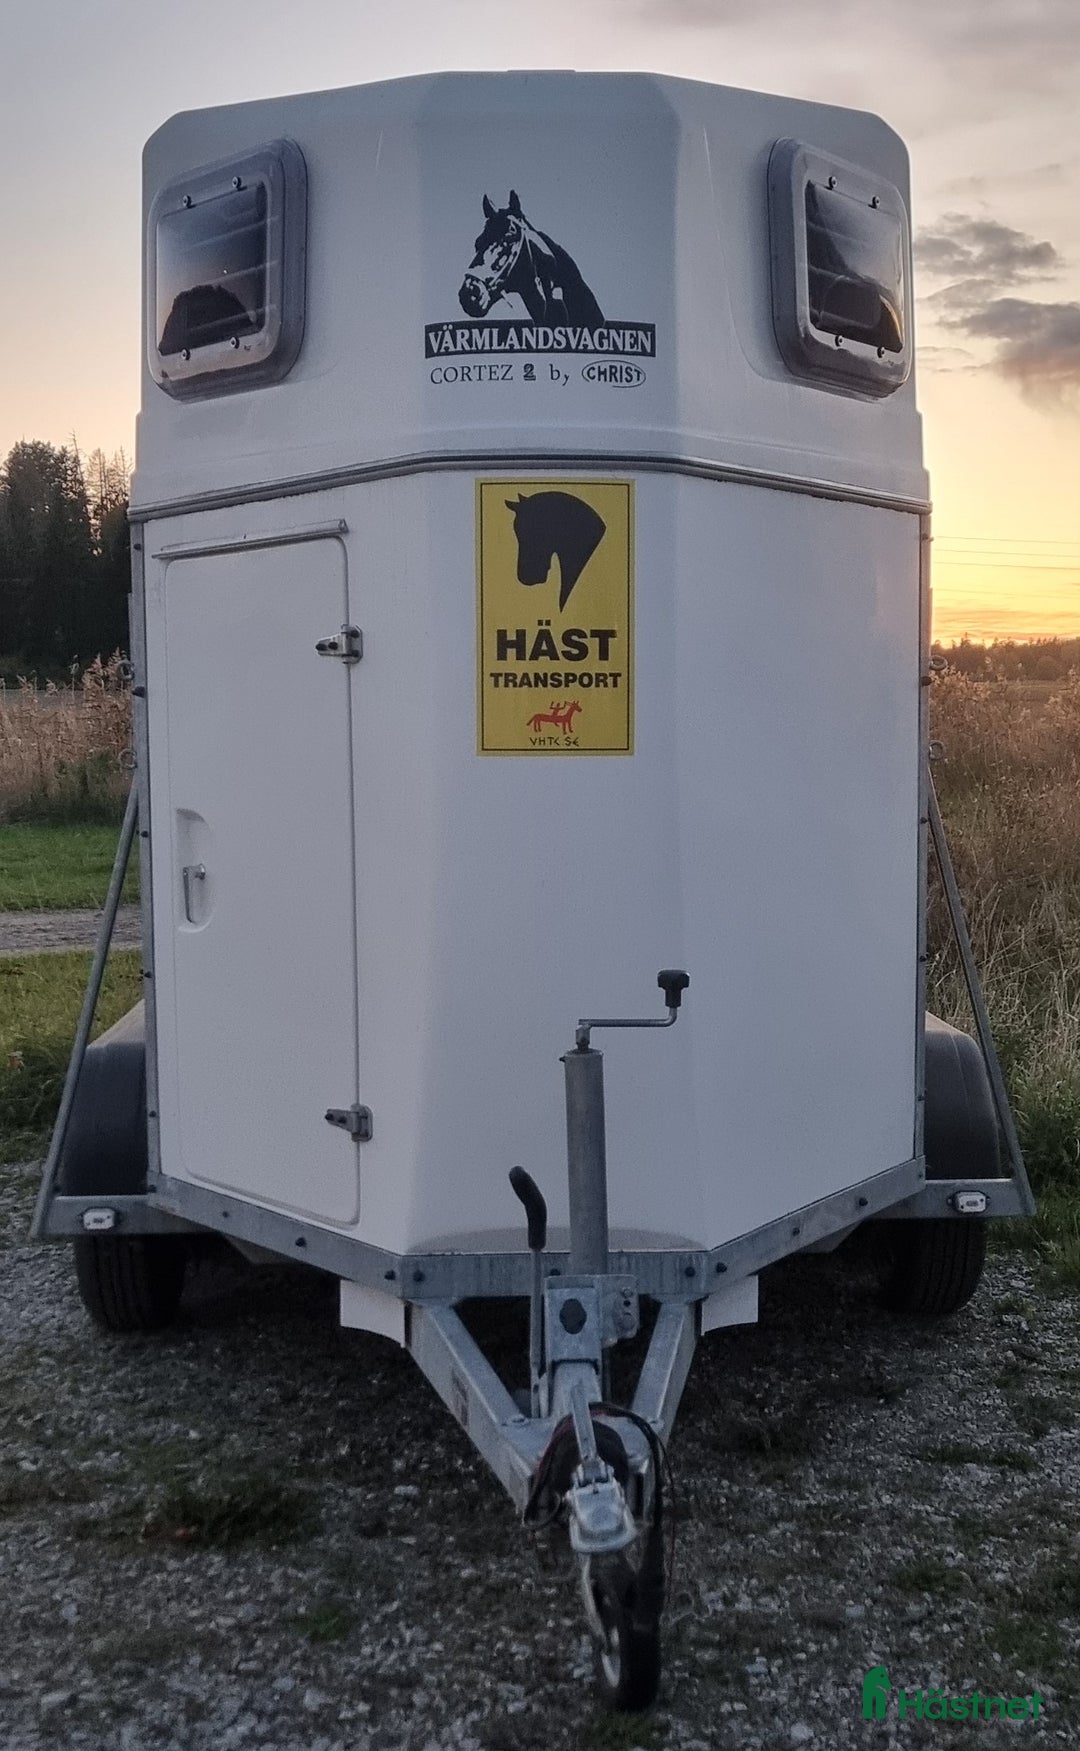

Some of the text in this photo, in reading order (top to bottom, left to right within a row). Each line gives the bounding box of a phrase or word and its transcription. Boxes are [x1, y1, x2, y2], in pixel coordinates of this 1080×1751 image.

[428, 324, 652, 353] VÄRMLANDSVAGNEN
[430, 363, 643, 386] CORTEZ 2 by CHRIST
[496, 619, 617, 661] HÄST
[490, 672, 621, 688] TRANSPORT
